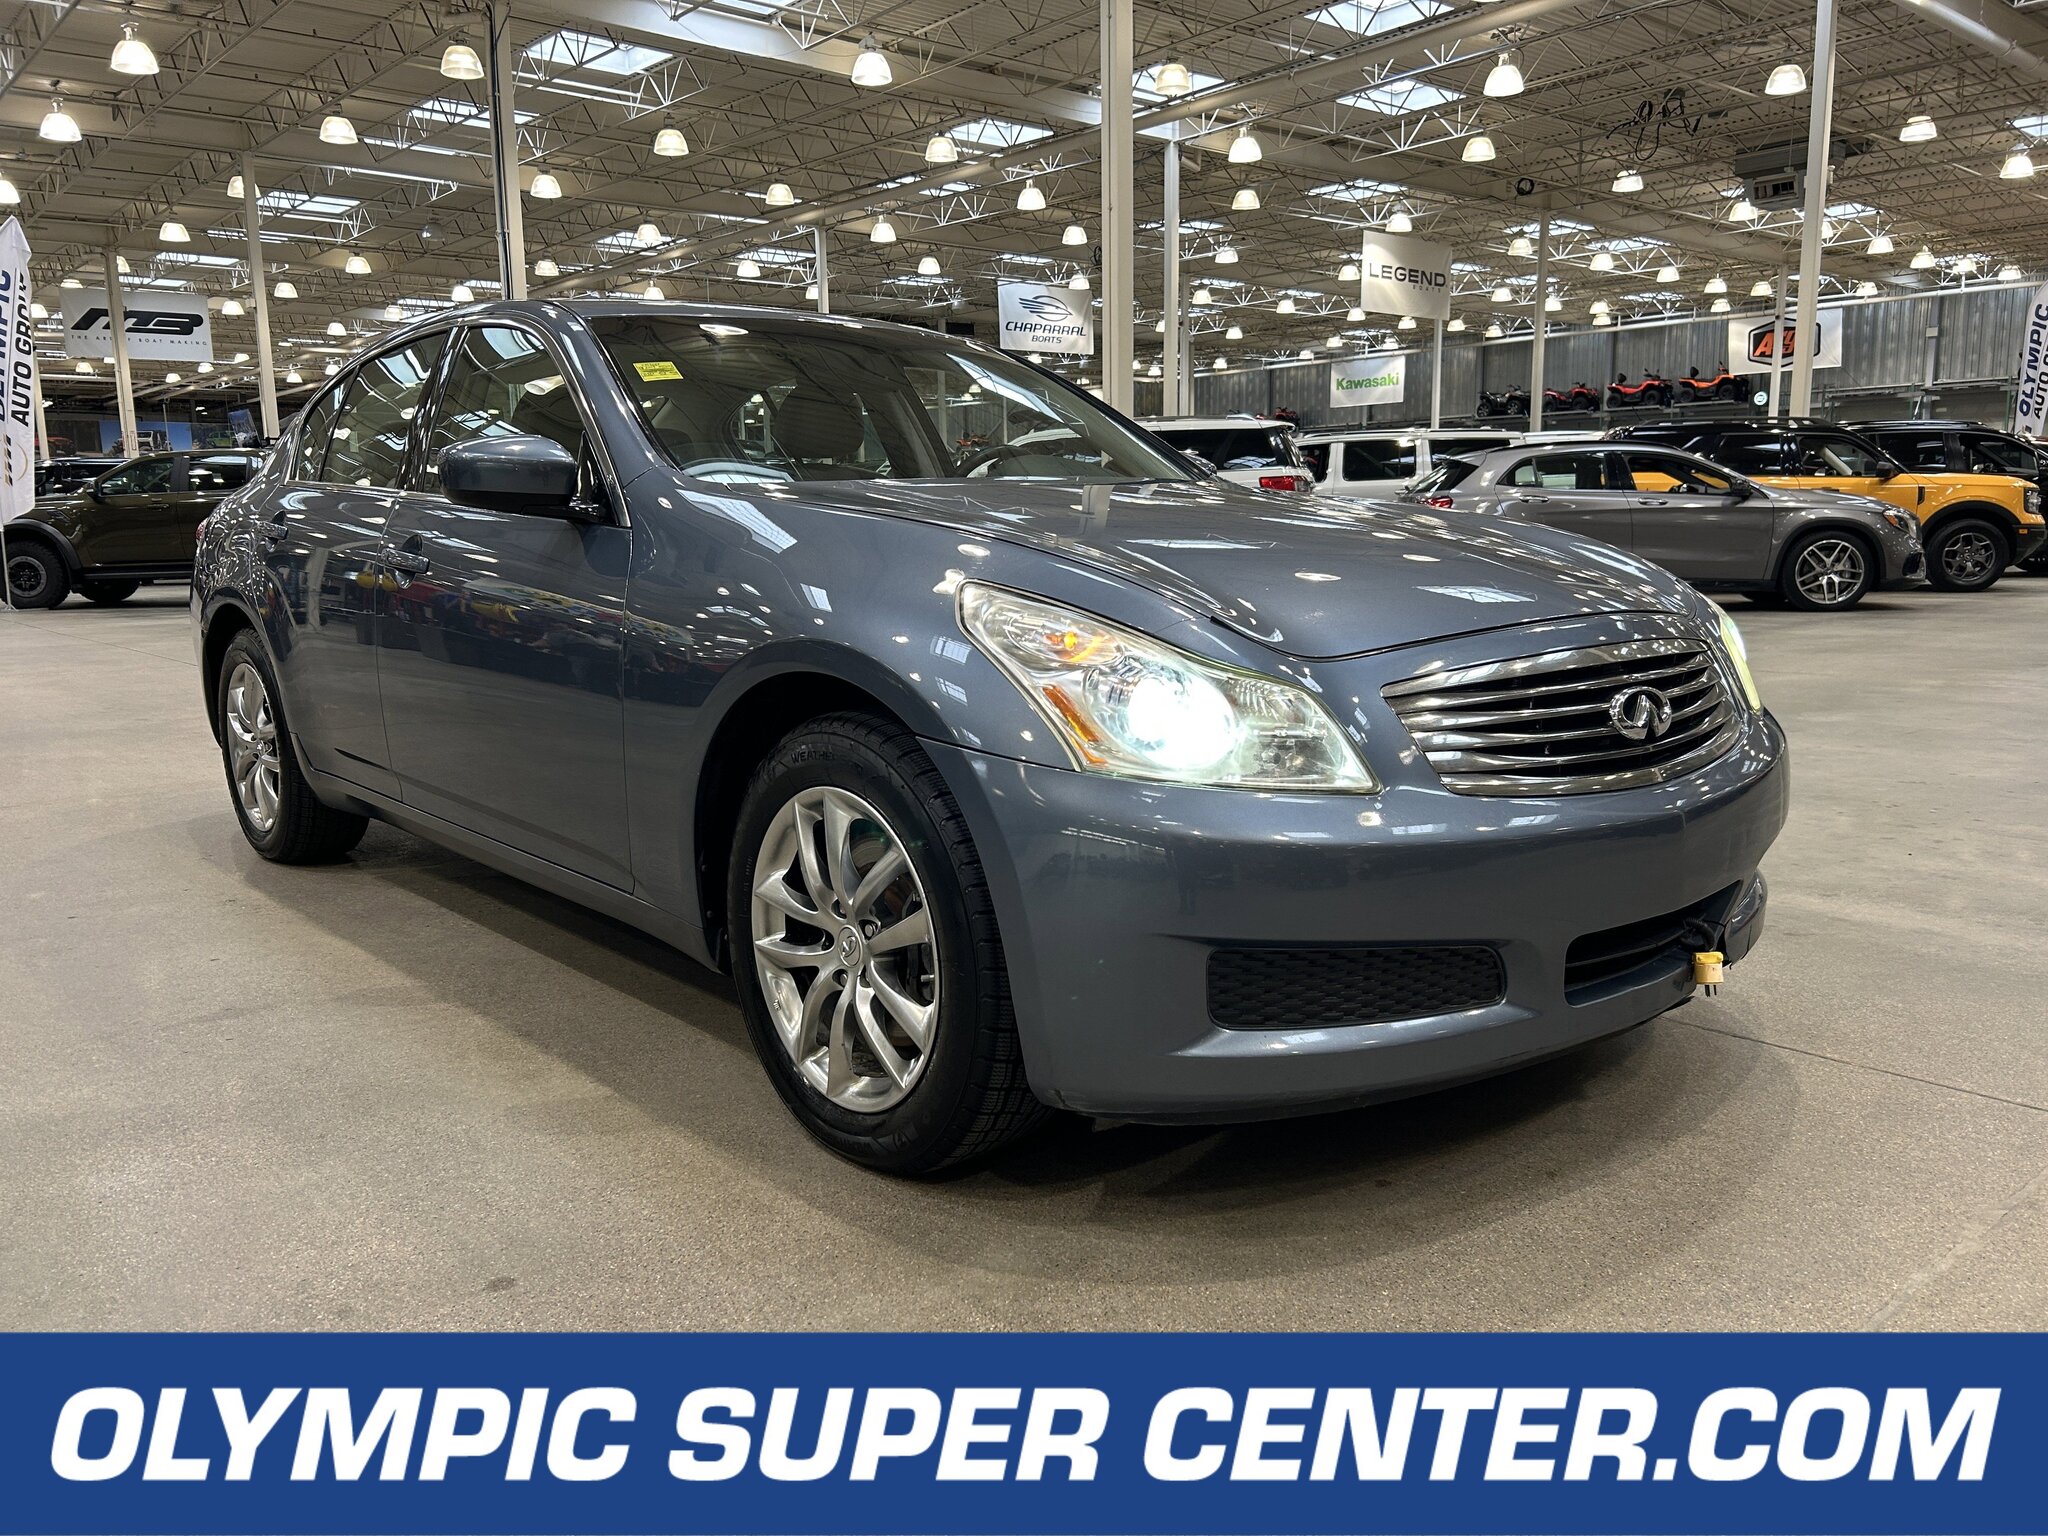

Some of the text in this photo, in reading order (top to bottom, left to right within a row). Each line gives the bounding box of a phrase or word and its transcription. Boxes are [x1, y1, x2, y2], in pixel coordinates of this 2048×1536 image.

[1369, 262, 1447, 288] LEGEND
[1005, 320, 1087, 337] CHAPARRAL
[1031, 334, 1063, 344] BOATS
[2019, 303, 2048, 417] OLYMPIC
[1335, 372, 1399, 391] Kawasaki
[11, 360, 32, 428] AUTO
